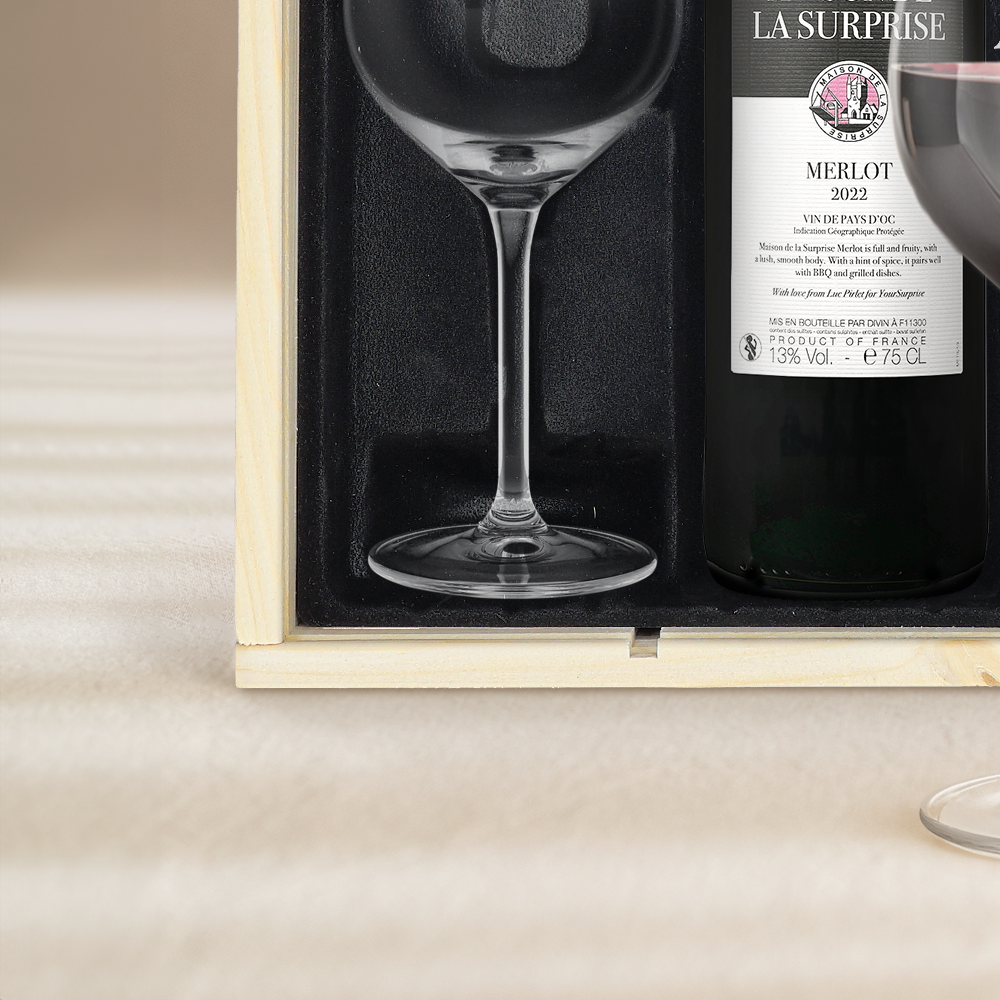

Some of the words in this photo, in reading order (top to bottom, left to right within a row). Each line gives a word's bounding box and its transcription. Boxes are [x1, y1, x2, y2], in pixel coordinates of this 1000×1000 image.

[753, 11, 792, 39] LA
[797, 10, 946, 41] SURPRISE
[819, 66, 864, 87] MAISON
[868, 73, 882, 88] DE
[879, 93, 887, 108] LA
[829, 114, 884, 140] SURPRISE
[806, 161, 893, 180] MERLOT
[830, 186, 868, 201] 2022
[803, 214, 822, 224] VIN
[823, 214, 839, 224] DE
[840, 214, 867, 225] PAYS
[868, 214, 896, 225] D'OC
[793, 226, 826, 235] Indication
[827, 226, 875, 237] Géographique
[876, 227, 905, 237] Protégée
[759, 242, 783, 251] Maison
[784, 243, 794, 252] de
[794, 243, 802, 252] la
[802, 243, 836, 254] Surprise
[837, 243, 863, 253] Merlot
[864, 244, 871, 252] is
[872, 244, 885, 253] full
[886, 244, 900, 253] and
[901, 243, 923, 255] fruity,
[923, 243, 938, 252] with
[759, 254, 776, 264] lush,
[776, 255, 804, 264] smooth
[804, 255, 826, 267] body.
[828, 256, 848, 264] With
[855, 256, 871, 265] hint
[872, 256, 881, 265] of
[881, 256, 904, 267] spice,
[904, 256, 910, 265] it
[911, 256, 928, 267] pairs
[928, 255, 942, 264] well
[795, 268, 811, 276] with
[813, 268, 832, 279] BBQ
[833, 268, 848, 277] and
[848, 268, 875, 280] grilled
[875, 268, 902, 277] dishes.
[772, 287, 789, 296] With
[790, 287, 806, 297] love
[804, 288, 826, 300] from
[826, 288, 843, 298] Luc
[843, 289, 865, 298] Pirlet
[863, 289, 877, 300] for
[879, 288, 926, 300] YourSurprise
[769, 317, 783, 326] MIS
[785, 317, 797, 326] EN
[798, 318, 846, 327] BOUTEILLE
[847, 318, 865, 328] PAR
[867, 318, 890, 328] DIVIN
[891, 317, 898, 327] À
[899, 318, 927, 327] F11300
[769, 335, 836, 346] PRODUCT
[845, 336, 863, 346] OF
[872, 336, 927, 346] FRANCE
[769, 346, 801, 365] 13%
[805, 347, 833, 365] Vol.
[881, 348, 901, 365] 75
[905, 347, 927, 365] CL
